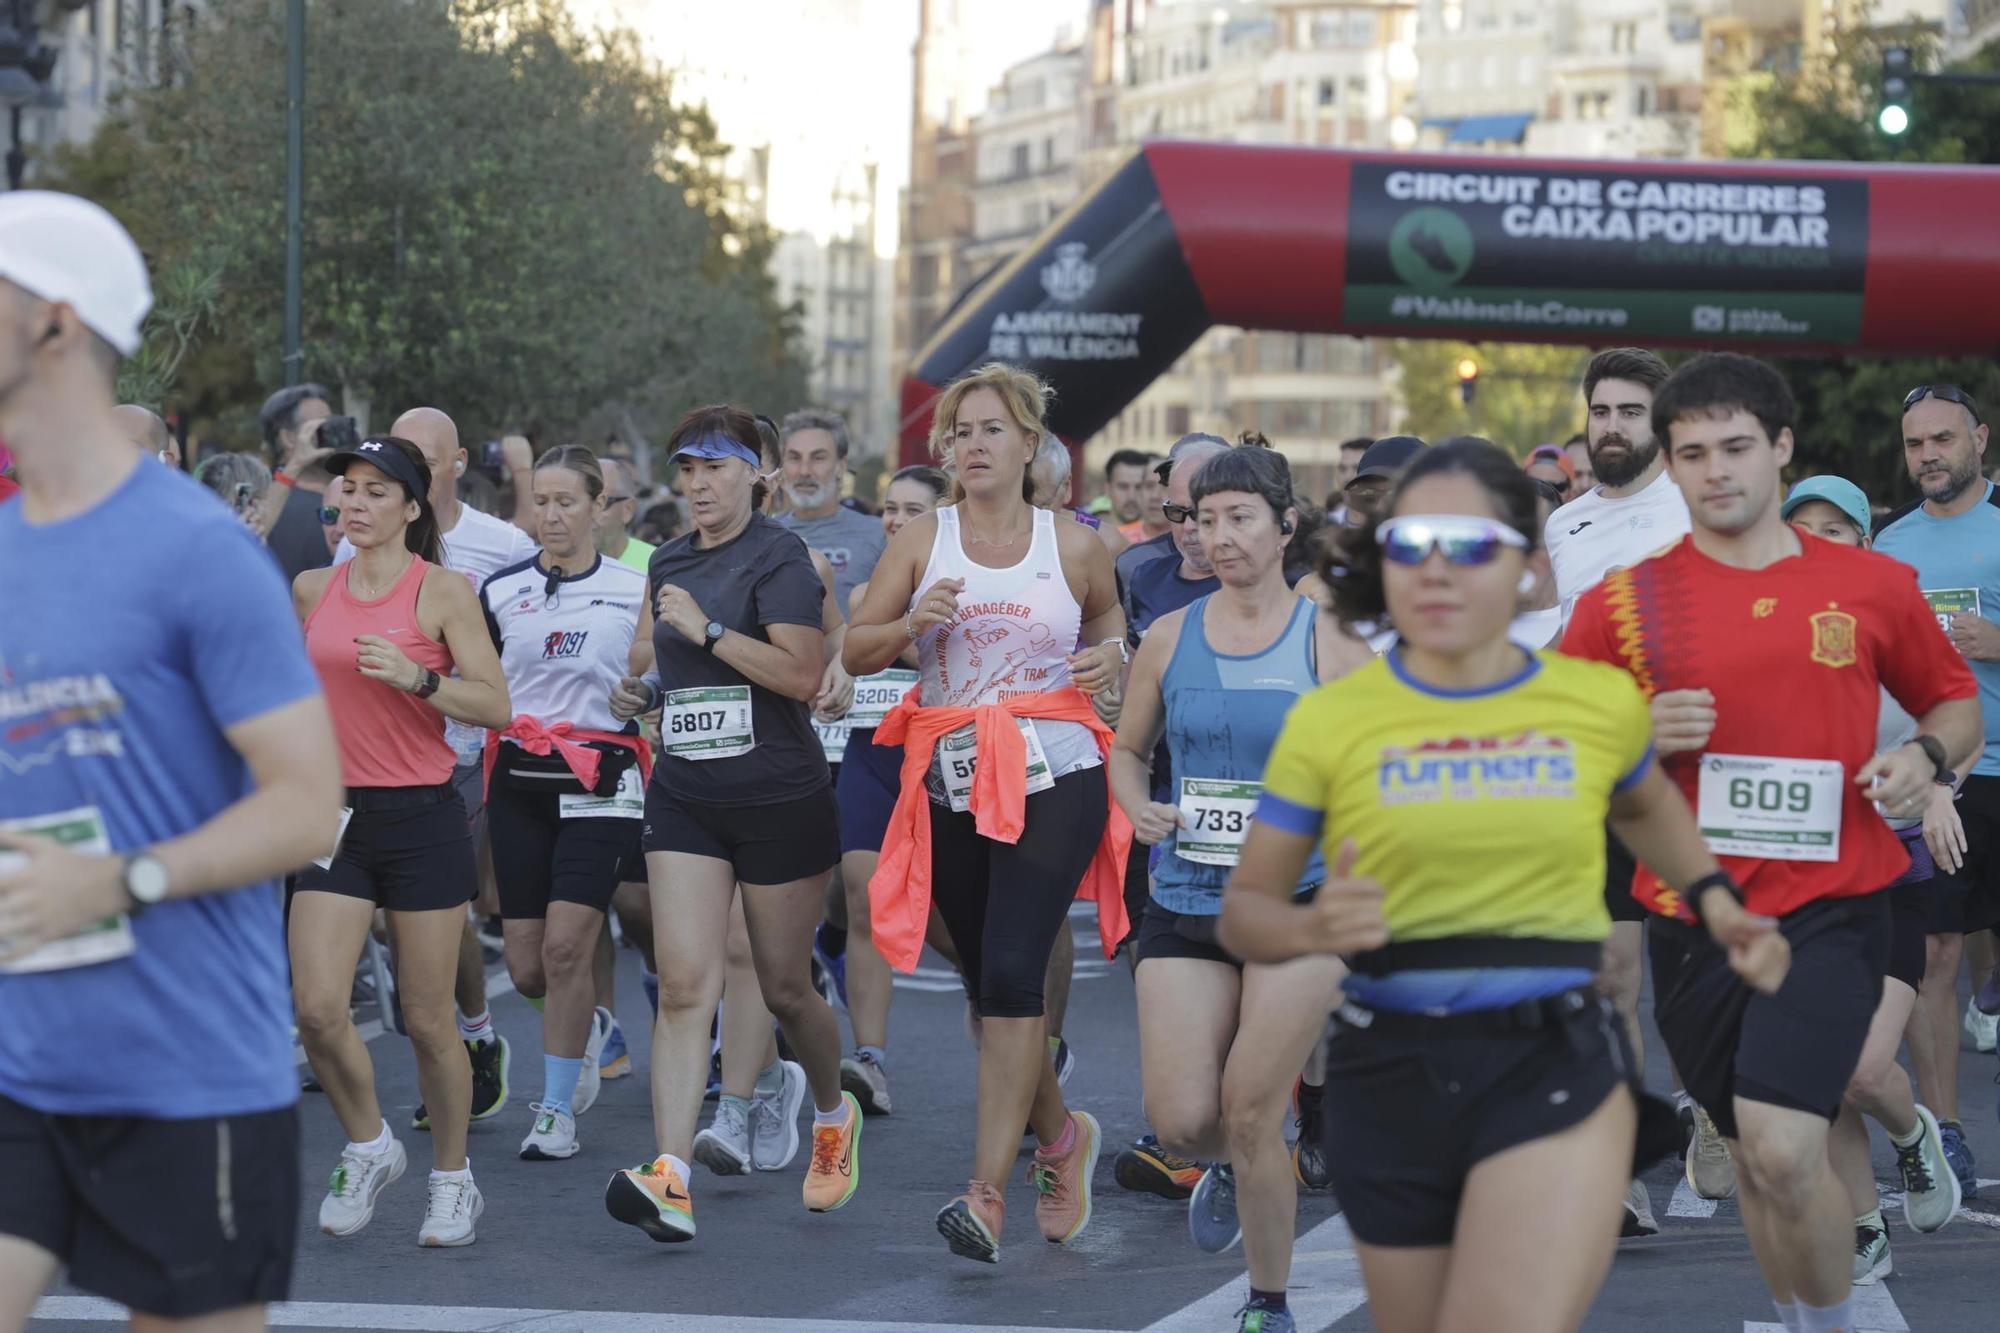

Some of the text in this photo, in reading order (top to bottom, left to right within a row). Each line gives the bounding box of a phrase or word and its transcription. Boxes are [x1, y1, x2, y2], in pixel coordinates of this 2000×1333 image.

[1385, 172, 1826, 214] CIRCUIT DE CARRERES
[990, 311, 1142, 335] AJUNTAMENT
[989, 335, 1020, 358] DE
[959, 600, 1031, 621] BENAGÉBER
[1935, 603, 1961, 613] Ritme
[856, 688, 899, 704] 5205
[671, 710, 727, 734] 5807
[1729, 777, 1812, 813] 609
[1194, 807, 1255, 833] 733
